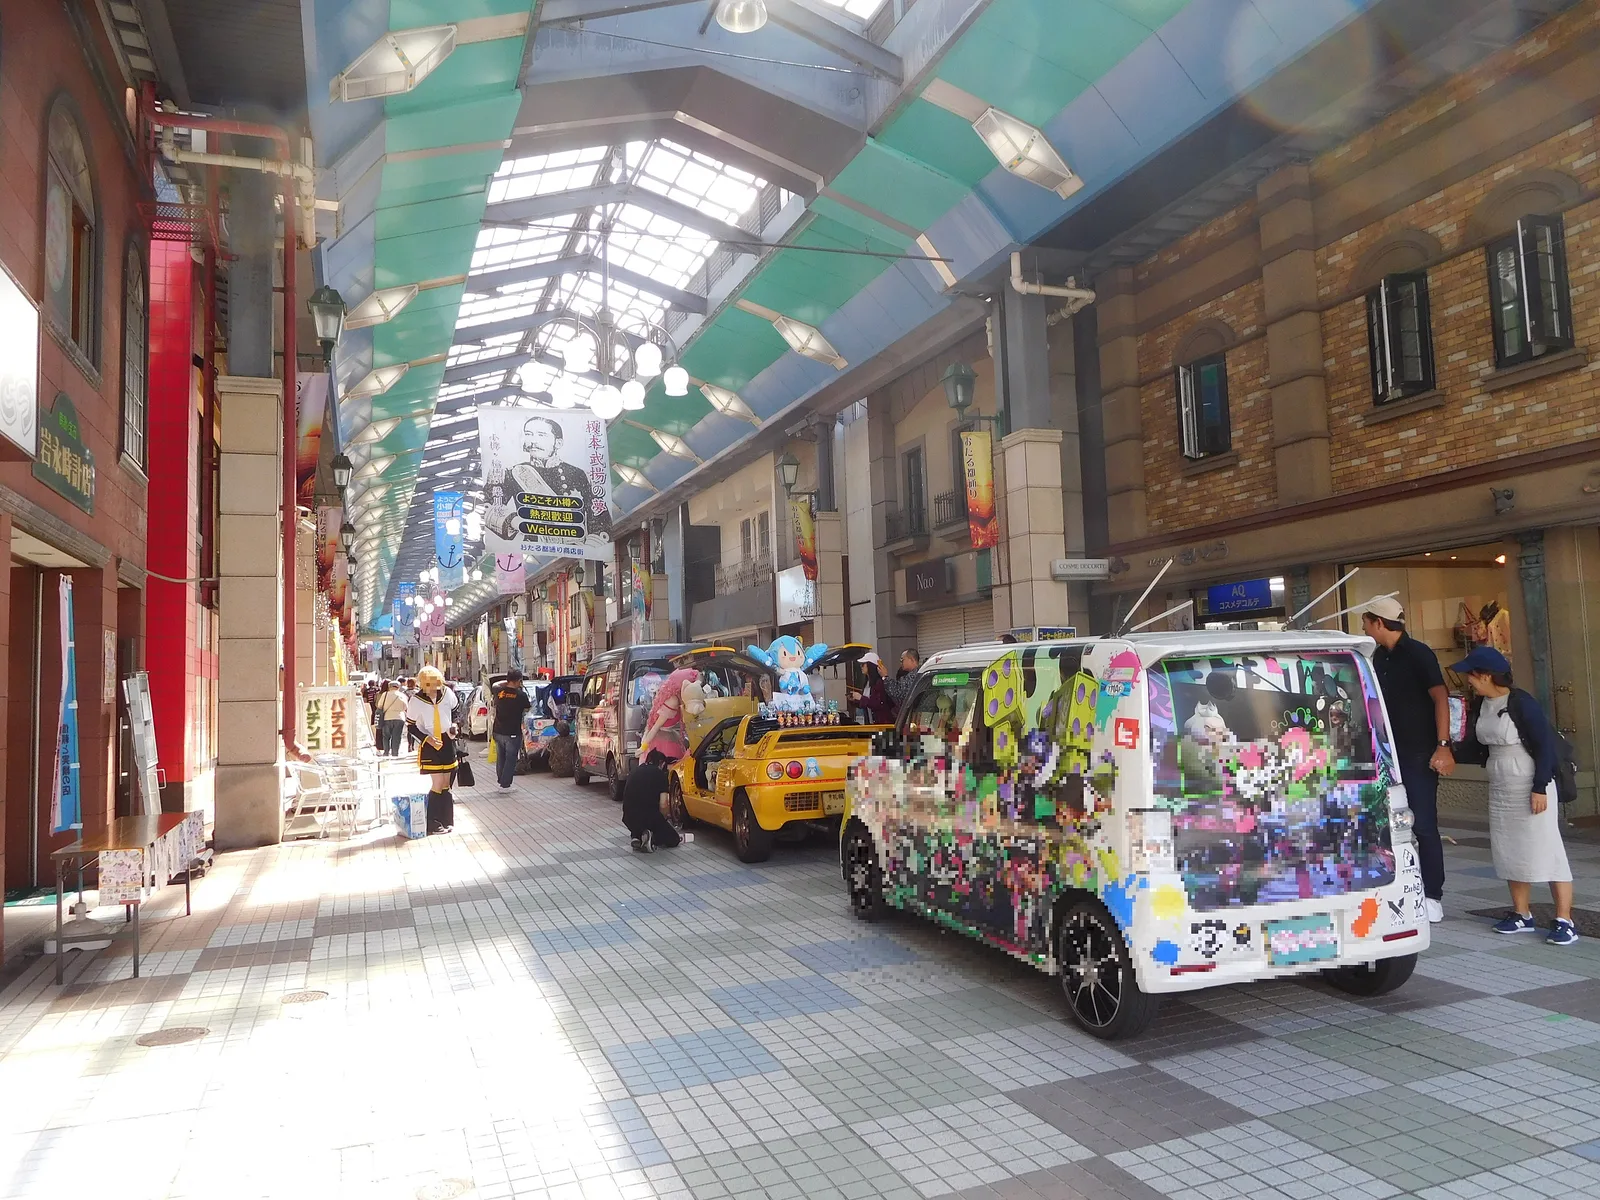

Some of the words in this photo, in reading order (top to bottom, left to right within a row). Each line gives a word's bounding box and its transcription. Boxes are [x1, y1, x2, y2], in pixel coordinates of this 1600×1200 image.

[585, 420, 607, 515] 榎本武揚の夢
[964, 437, 978, 499] おたる都通り
[522, 494, 580, 508] ようこそ小樽へ
[526, 523, 577, 537] Welcome
[520, 544, 584, 556] おたる都通り商店街
[916, 573, 935, 591] Nao
[1231, 584, 1246, 597] AQ
[1219, 597, 1260, 610] コスメデコルテ
[306, 698, 321, 750] パチンコ
[330, 697, 347, 749] パチスロ
